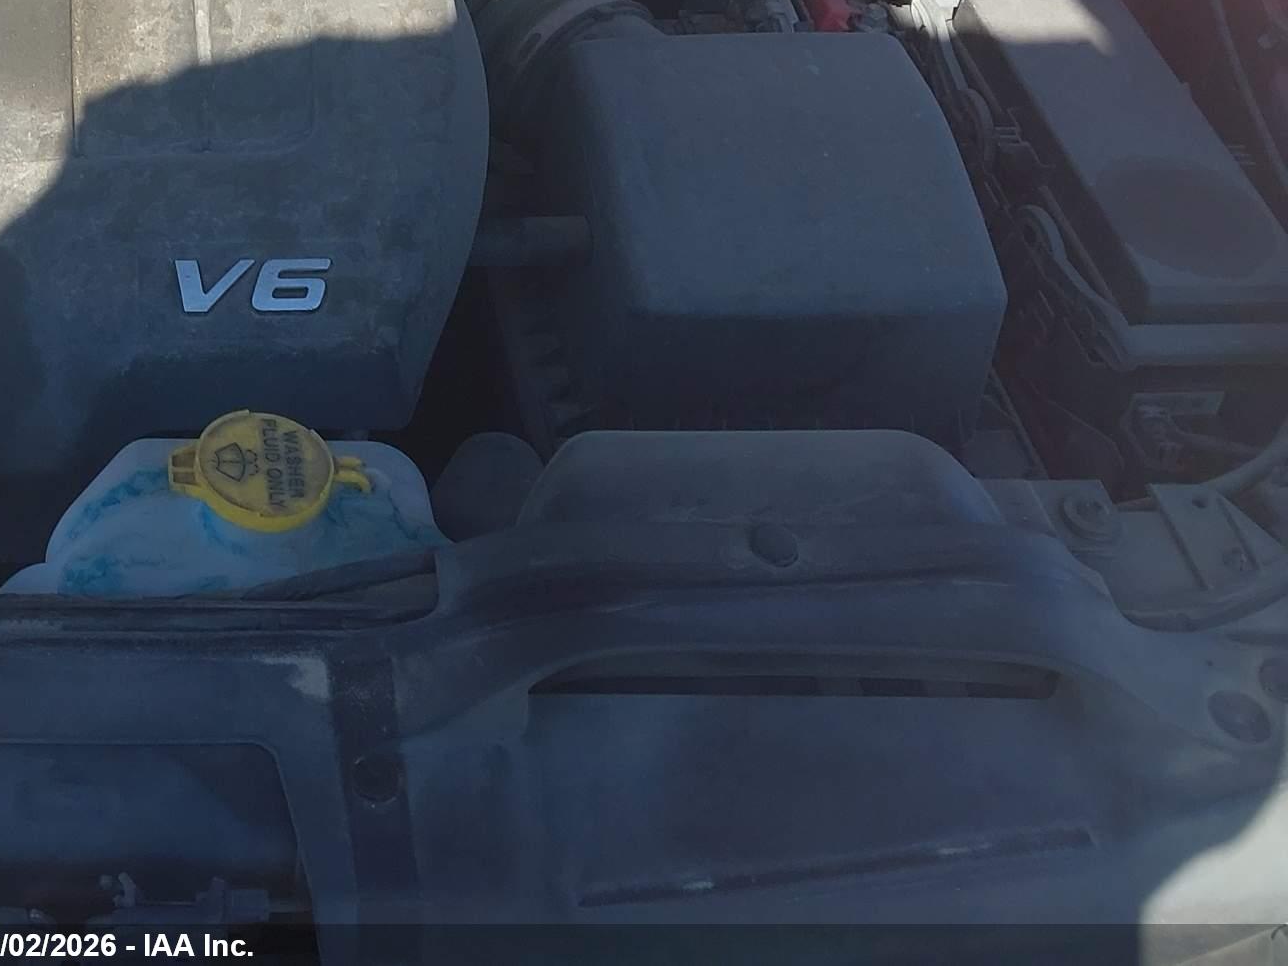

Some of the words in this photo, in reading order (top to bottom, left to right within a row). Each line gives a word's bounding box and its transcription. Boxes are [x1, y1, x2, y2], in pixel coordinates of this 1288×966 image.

[175, 258, 332, 313] V6
[261, 418, 282, 463] FLUID
[283, 430, 305, 499] WASHER
[267, 467, 287, 509] ONLY
